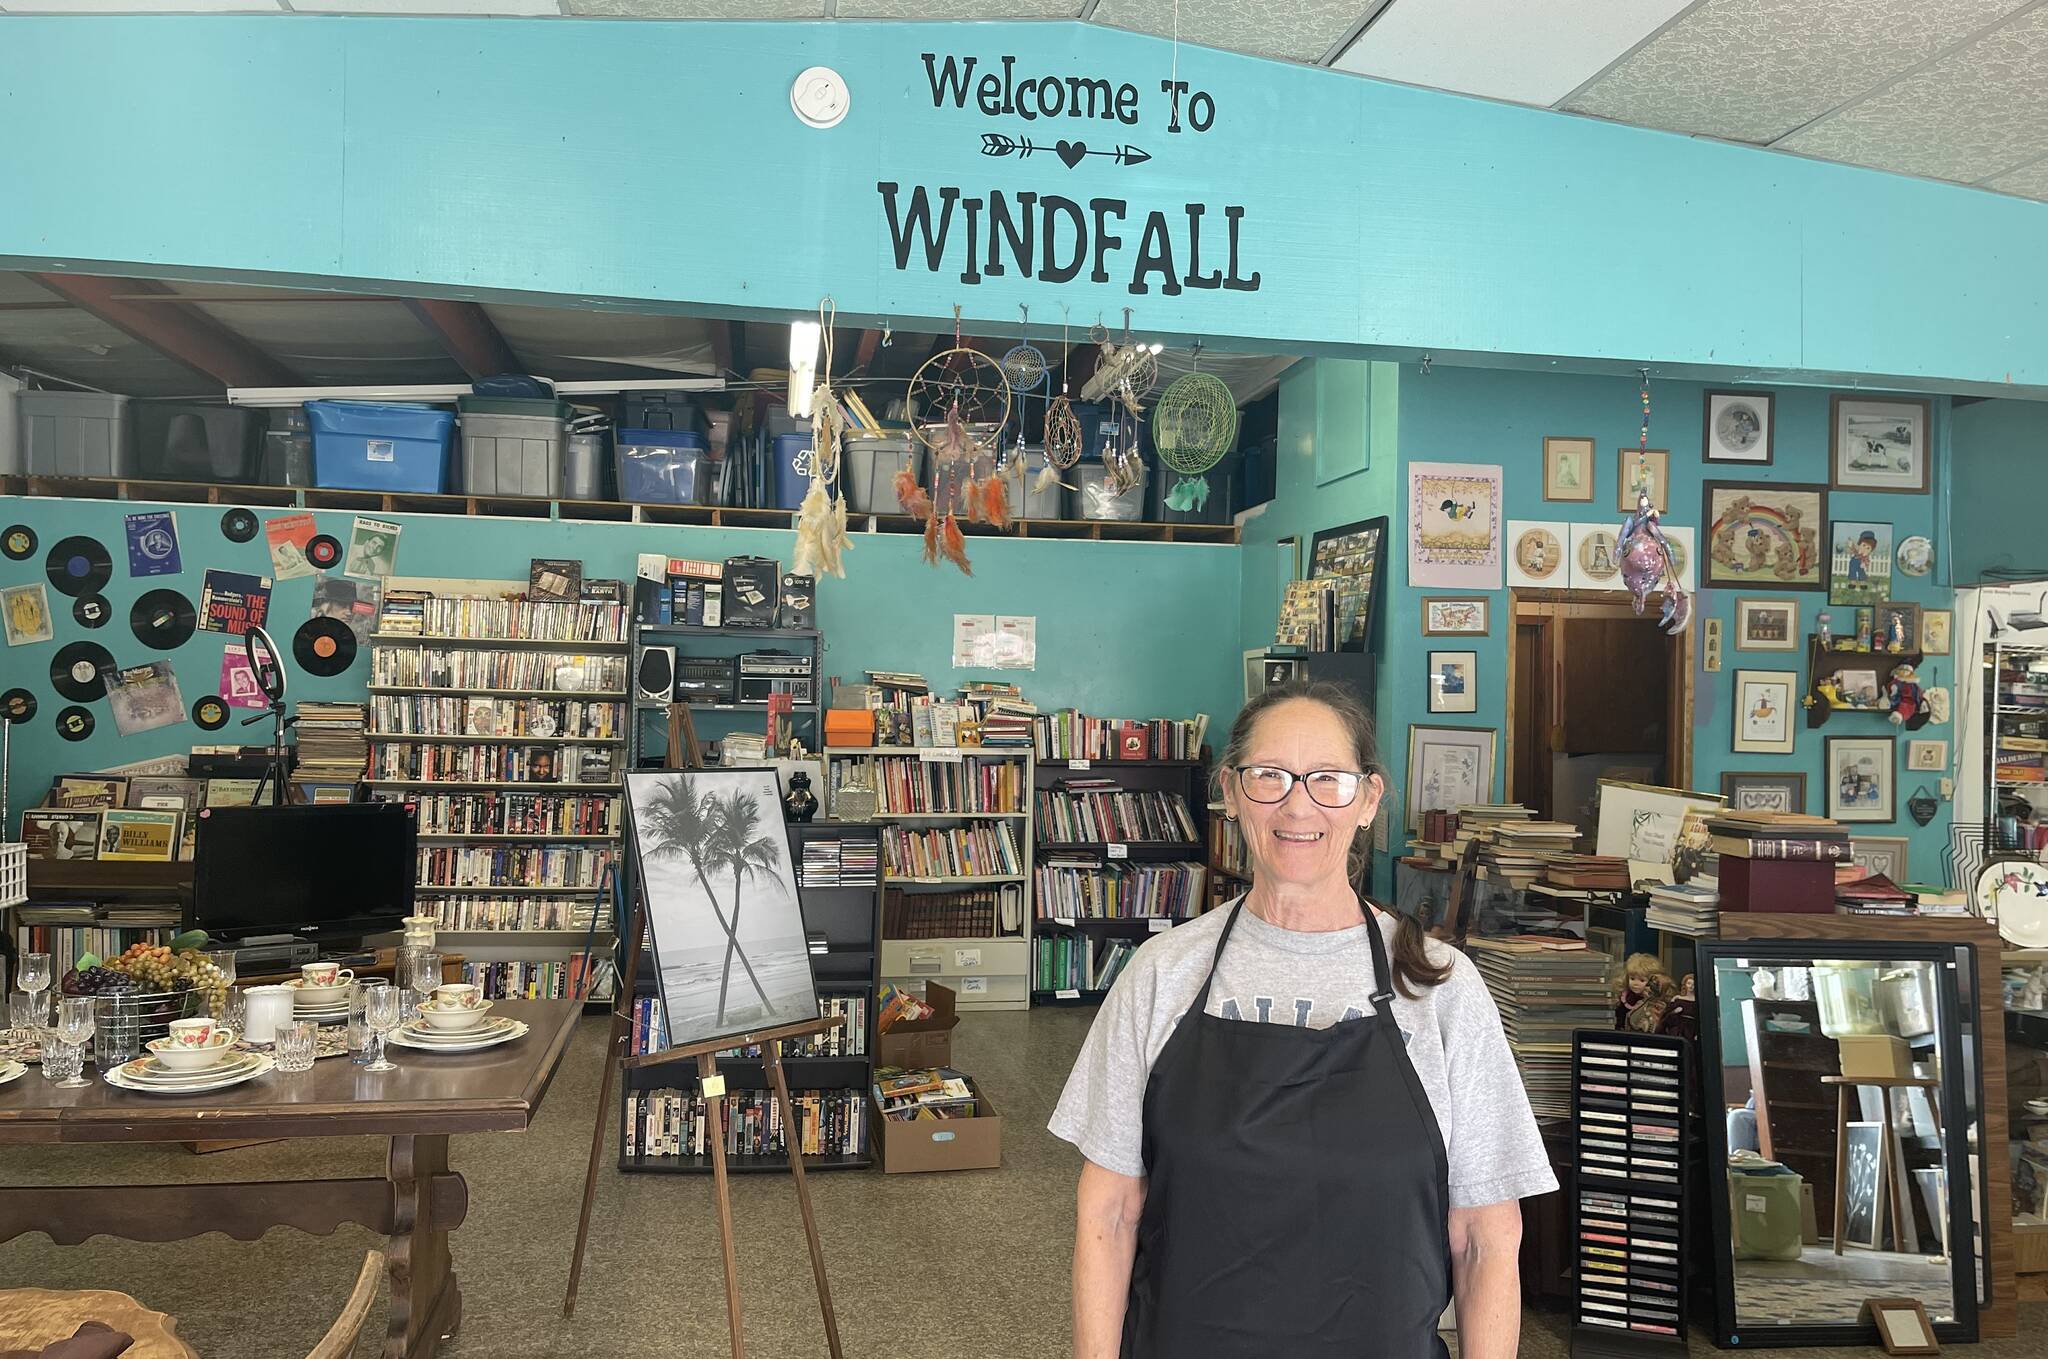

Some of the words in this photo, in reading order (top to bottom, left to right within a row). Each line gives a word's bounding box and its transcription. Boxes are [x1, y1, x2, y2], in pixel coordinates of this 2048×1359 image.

[921, 53, 1138, 125] Welcome
[1161, 80, 1215, 133] To
[877, 181, 1261, 296] WINDFALL
[245, 593, 267, 609] THE
[210, 603, 247, 621] SOUND
[250, 608, 264, 622] OF
[122, 838, 168, 848] WILLIAMS
[123, 829, 149, 840] BILLY
